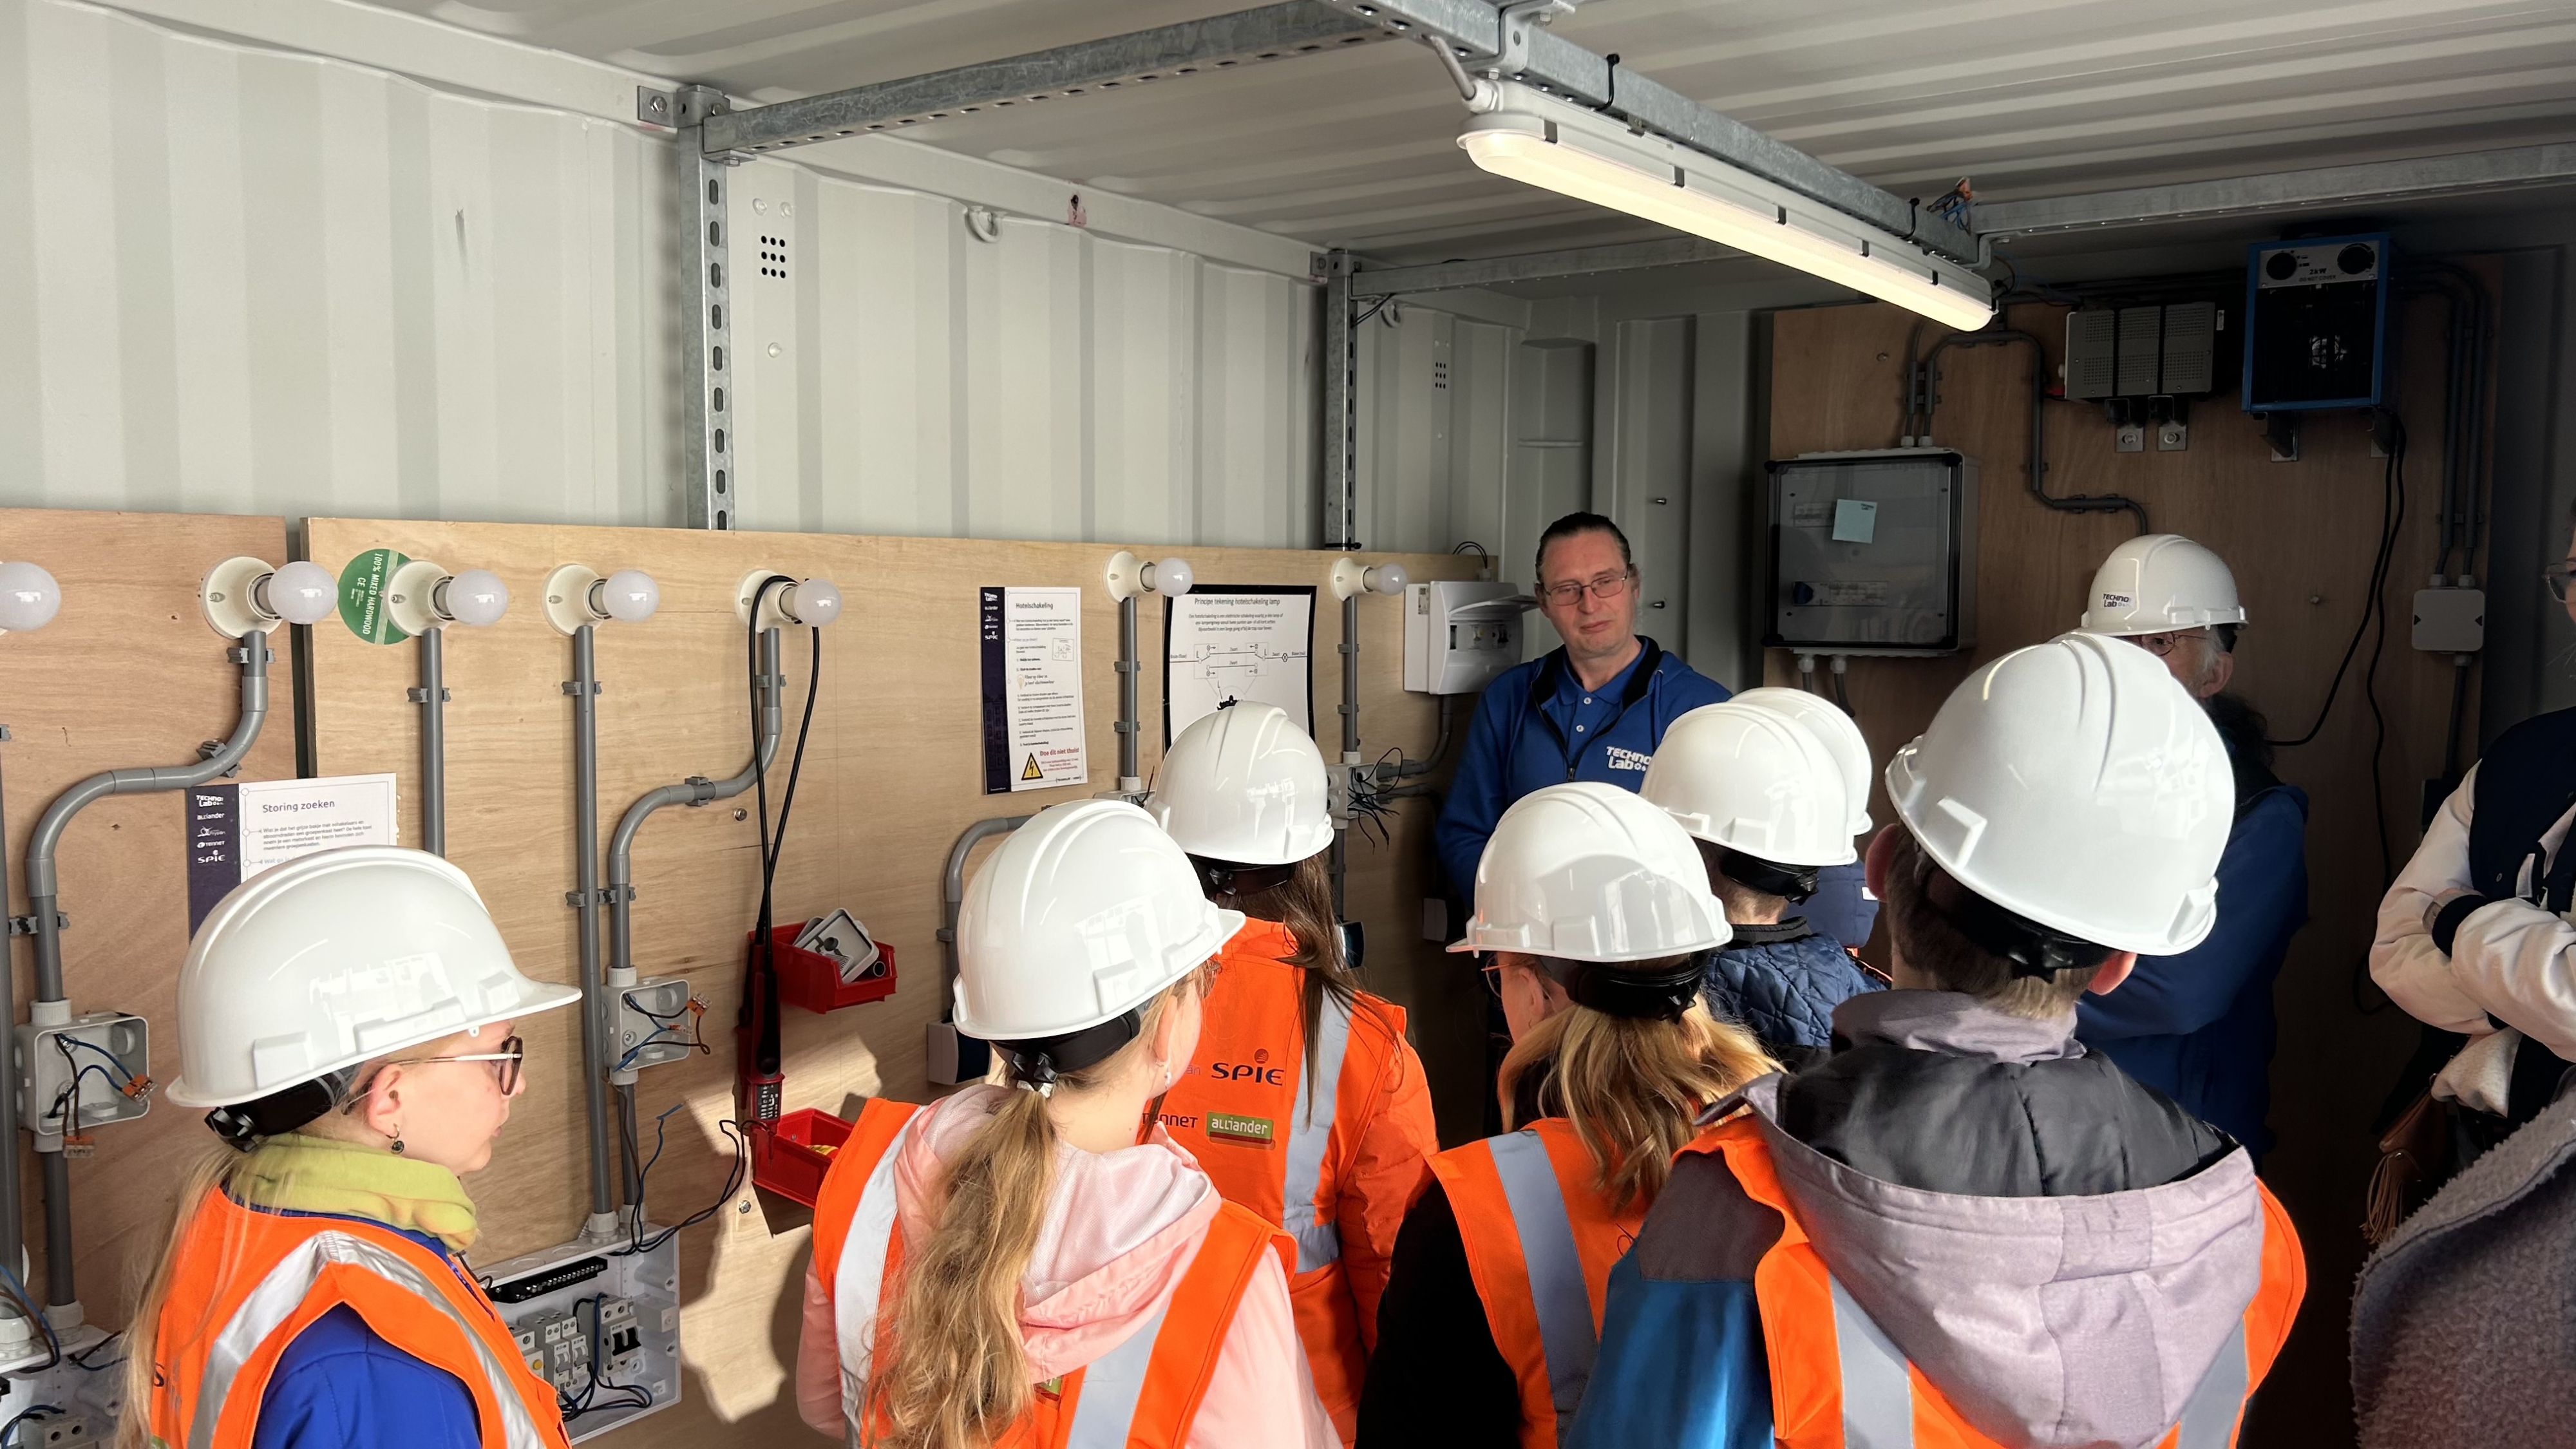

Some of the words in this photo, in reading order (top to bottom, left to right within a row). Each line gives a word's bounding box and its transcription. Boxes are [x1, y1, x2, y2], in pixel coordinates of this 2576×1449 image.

[372, 553, 383, 573] 100%
[357, 577, 366, 587] CE
[368, 573, 380, 595] MIXED
[1195, 598, 1213, 606] Principe
[1214, 598, 1234, 606] tekening
[1235, 598, 1268, 606] hotelschakeling
[1269, 598, 1280, 606] lamp
[2103, 593, 2129, 602] TECHNO
[2104, 599, 2117, 607] Lab
[363, 596, 376, 634] HARDWOOD
[1606, 746, 1653, 765] TECHNO
[1608, 756, 1634, 770] Lab
[263, 802, 298, 813] Storing
[301, 800, 335, 810] zoeken
[198, 854, 225, 864] SPIE
[1211, 1063, 1285, 1086] SPIE
[1142, 1113, 1198, 1128] TnneT
[1211, 1117, 1268, 1135] alliander
